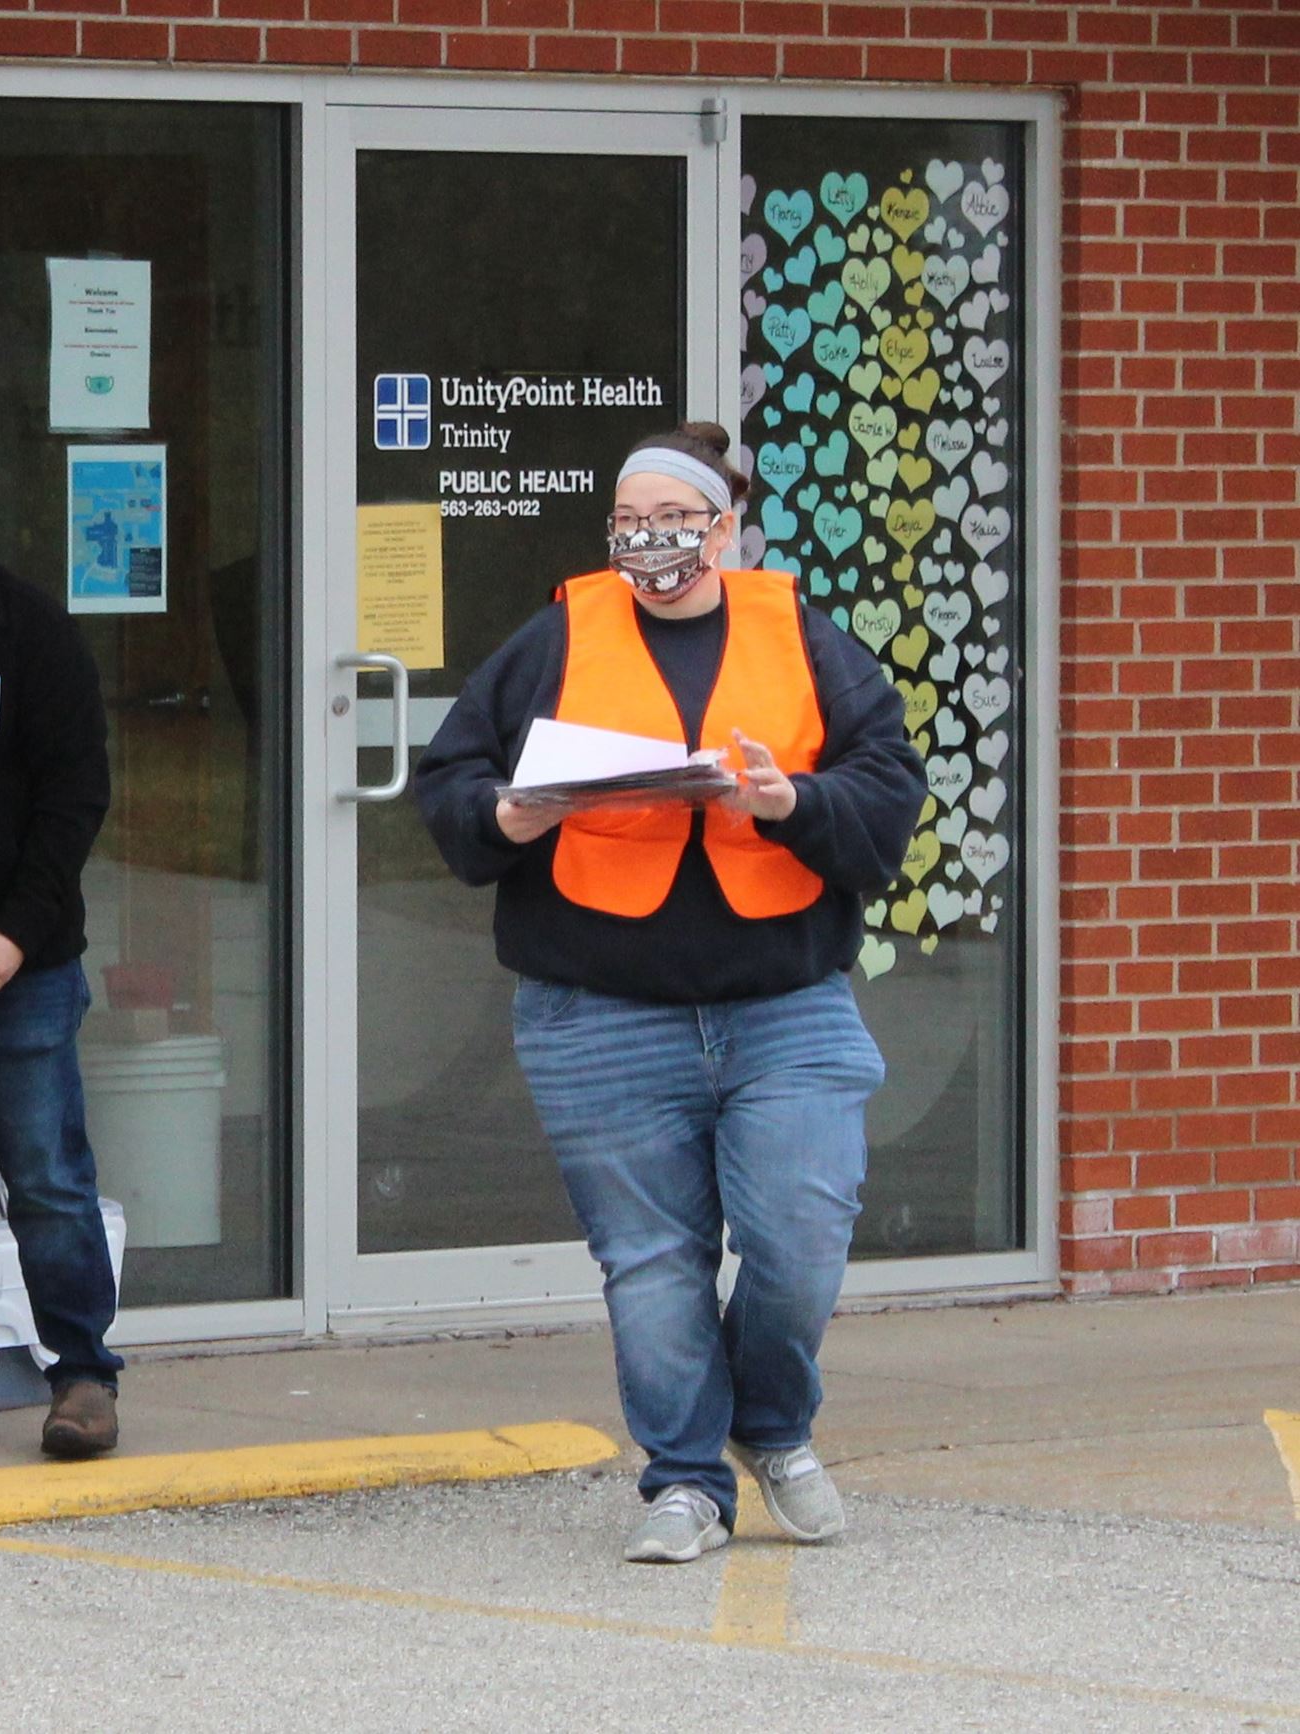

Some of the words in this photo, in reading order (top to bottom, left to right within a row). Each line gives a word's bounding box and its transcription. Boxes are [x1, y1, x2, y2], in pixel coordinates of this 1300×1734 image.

[440, 376, 576, 413] UnityPoint
[582, 377, 663, 407] Health
[440, 423, 512, 453] Trinity
[439, 470, 512, 494] PUBLIC
[519, 470, 595, 493] HEALTH
[440, 500, 541, 517] 563-263-0122
[820, 518, 847, 543] Tyler
[972, 689, 1001, 711] Sue
